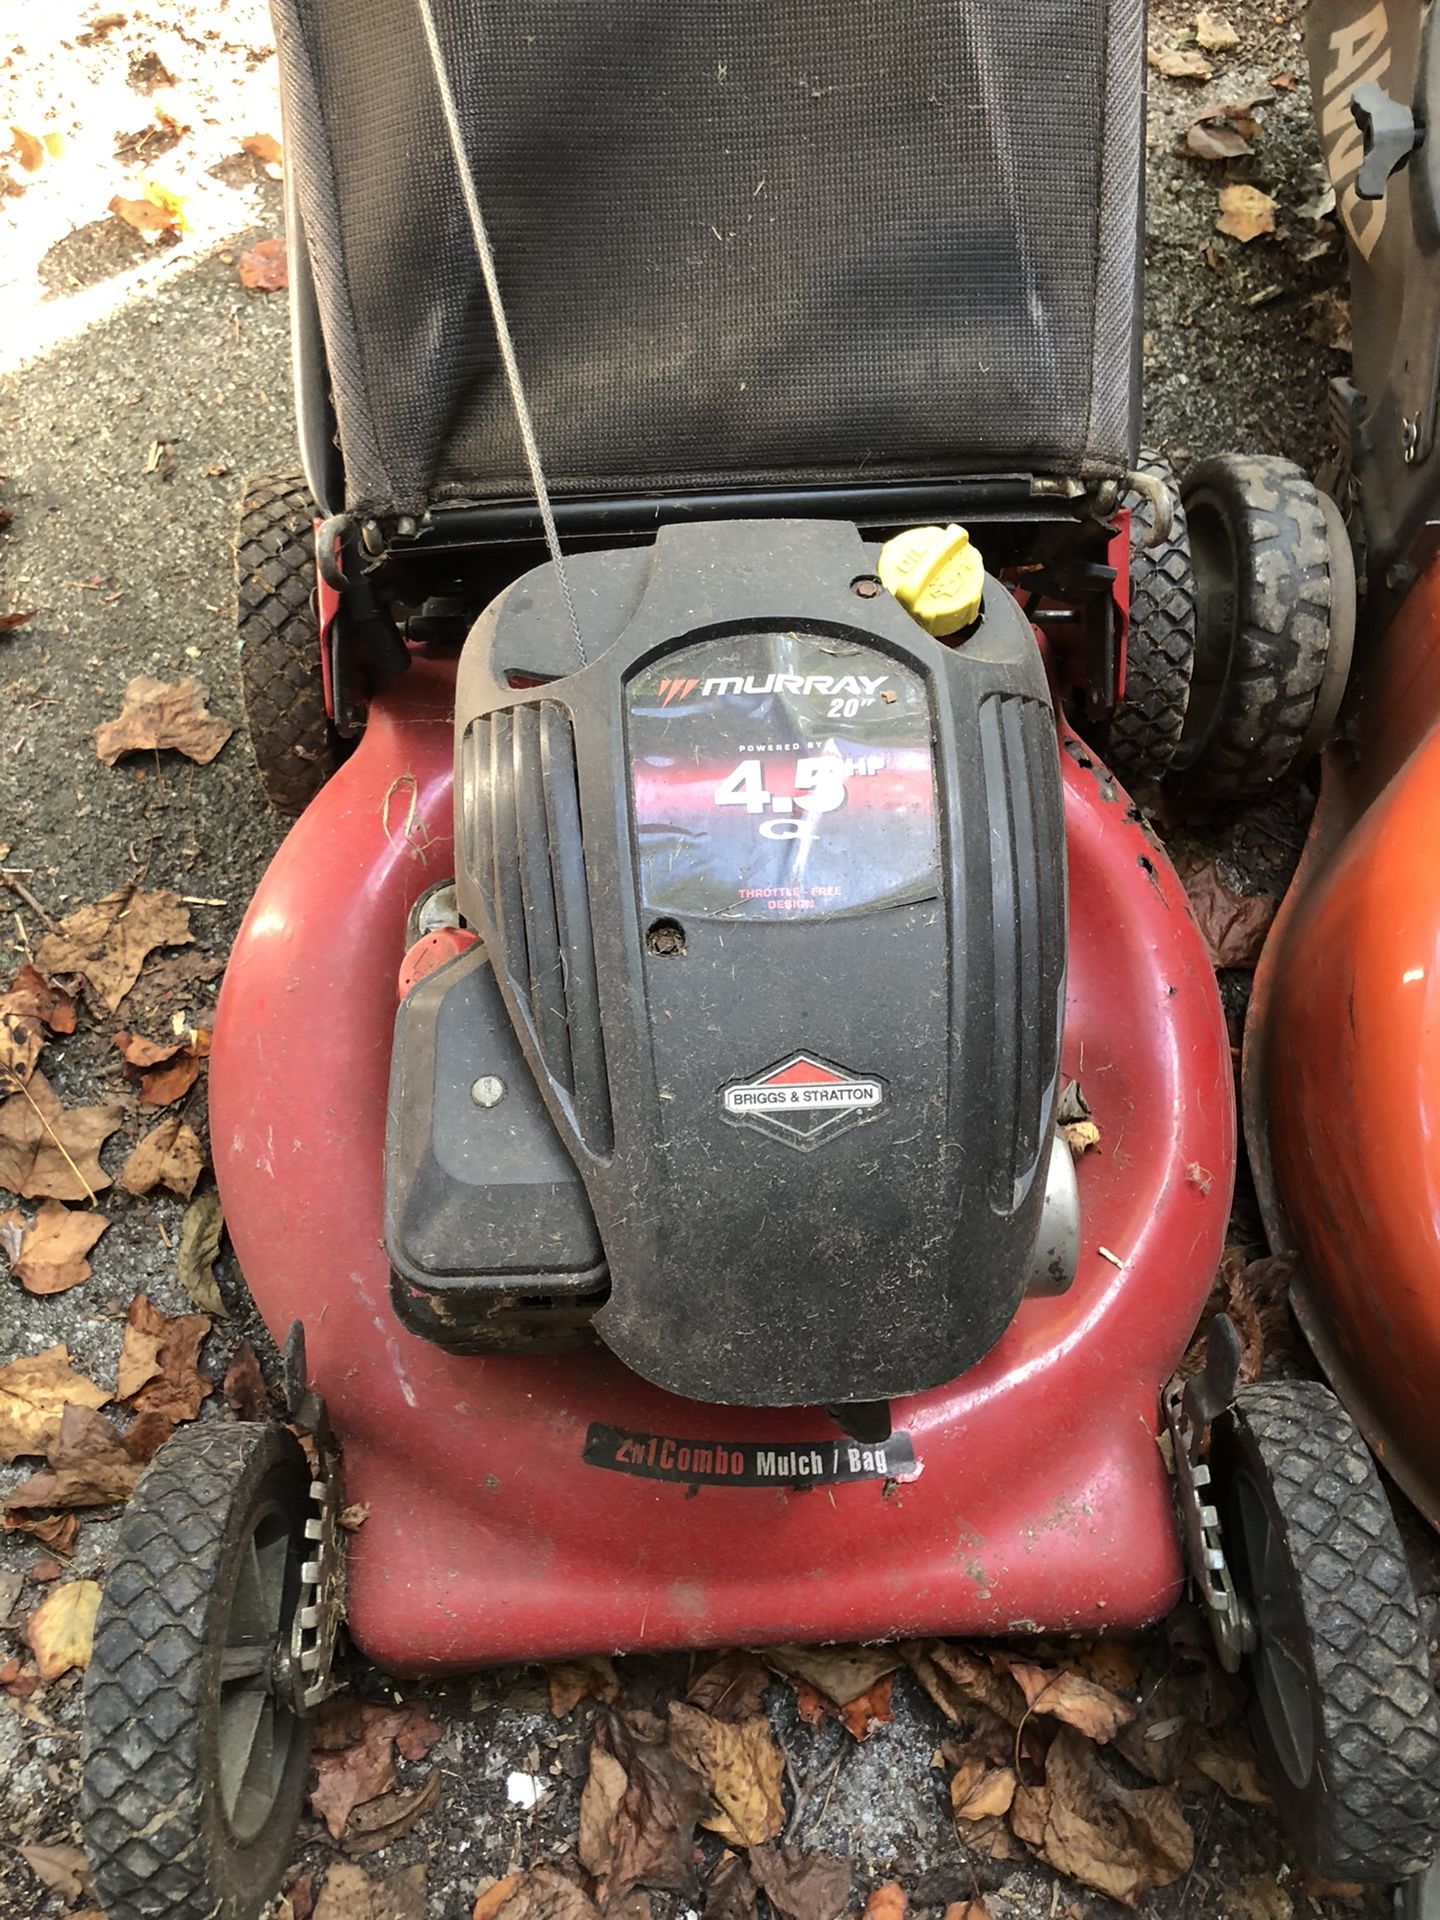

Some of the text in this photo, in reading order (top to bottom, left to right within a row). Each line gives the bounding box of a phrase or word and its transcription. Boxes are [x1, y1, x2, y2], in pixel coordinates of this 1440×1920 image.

[702, 673, 889, 697] MURRAY
[827, 698, 876, 718] 20"
[739, 741, 823, 752] POWERED BY
[714, 756, 887, 815] 4.5 HP
[811, 886, 842, 896] FREE
[768, 900, 814, 909] DESIGN
[734, 1087, 874, 1105] BRIGGS & STRATTON
[756, 1451, 824, 1477] Mulch
[848, 1448, 888, 1474] Bag
